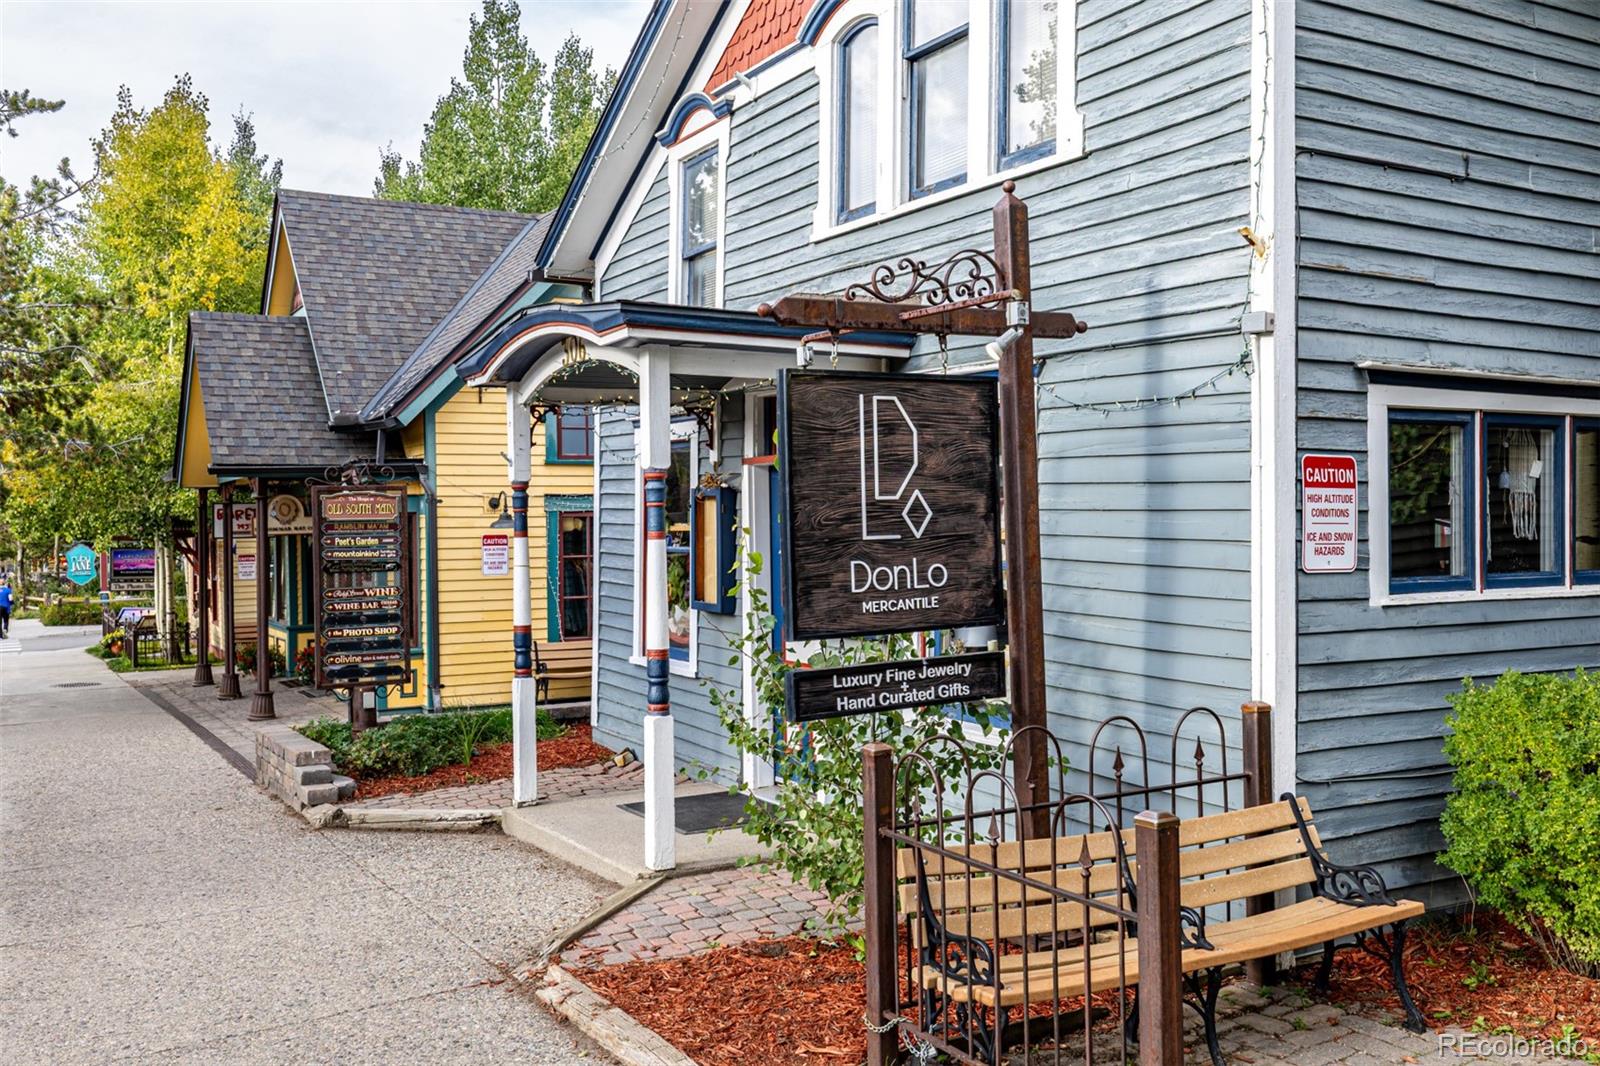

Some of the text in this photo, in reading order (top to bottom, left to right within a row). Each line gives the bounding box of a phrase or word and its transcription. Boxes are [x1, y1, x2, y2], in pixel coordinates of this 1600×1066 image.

[1306, 467, 1354, 483] CAUTION
[1307, 494, 1354, 504] HIGH ALTITUDE
[327, 503, 395, 515] OLD SOUTH MAIN
[1311, 508, 1349, 518] CONDITIONS
[356, 536, 379, 546] Garden
[1307, 532, 1353, 542] ICE AND SNOW
[333, 550, 379, 558] mountainkind
[1314, 546, 1345, 556] HAZARDS
[850, 557, 948, 593] DonLo
[364, 587, 399, 597] WINE
[334, 602, 360, 611] WINE
[361, 601, 379, 609] BAR
[862, 596, 940, 614] MERCANTILE
[343, 628, 373, 637] PHOTO
[374, 626, 398, 635] SHOP
[334, 654, 362, 664] olivine
[833, 662, 972, 689] Luxury Fine Jewelry
[836, 683, 970, 711] Hand Curated Gifts
